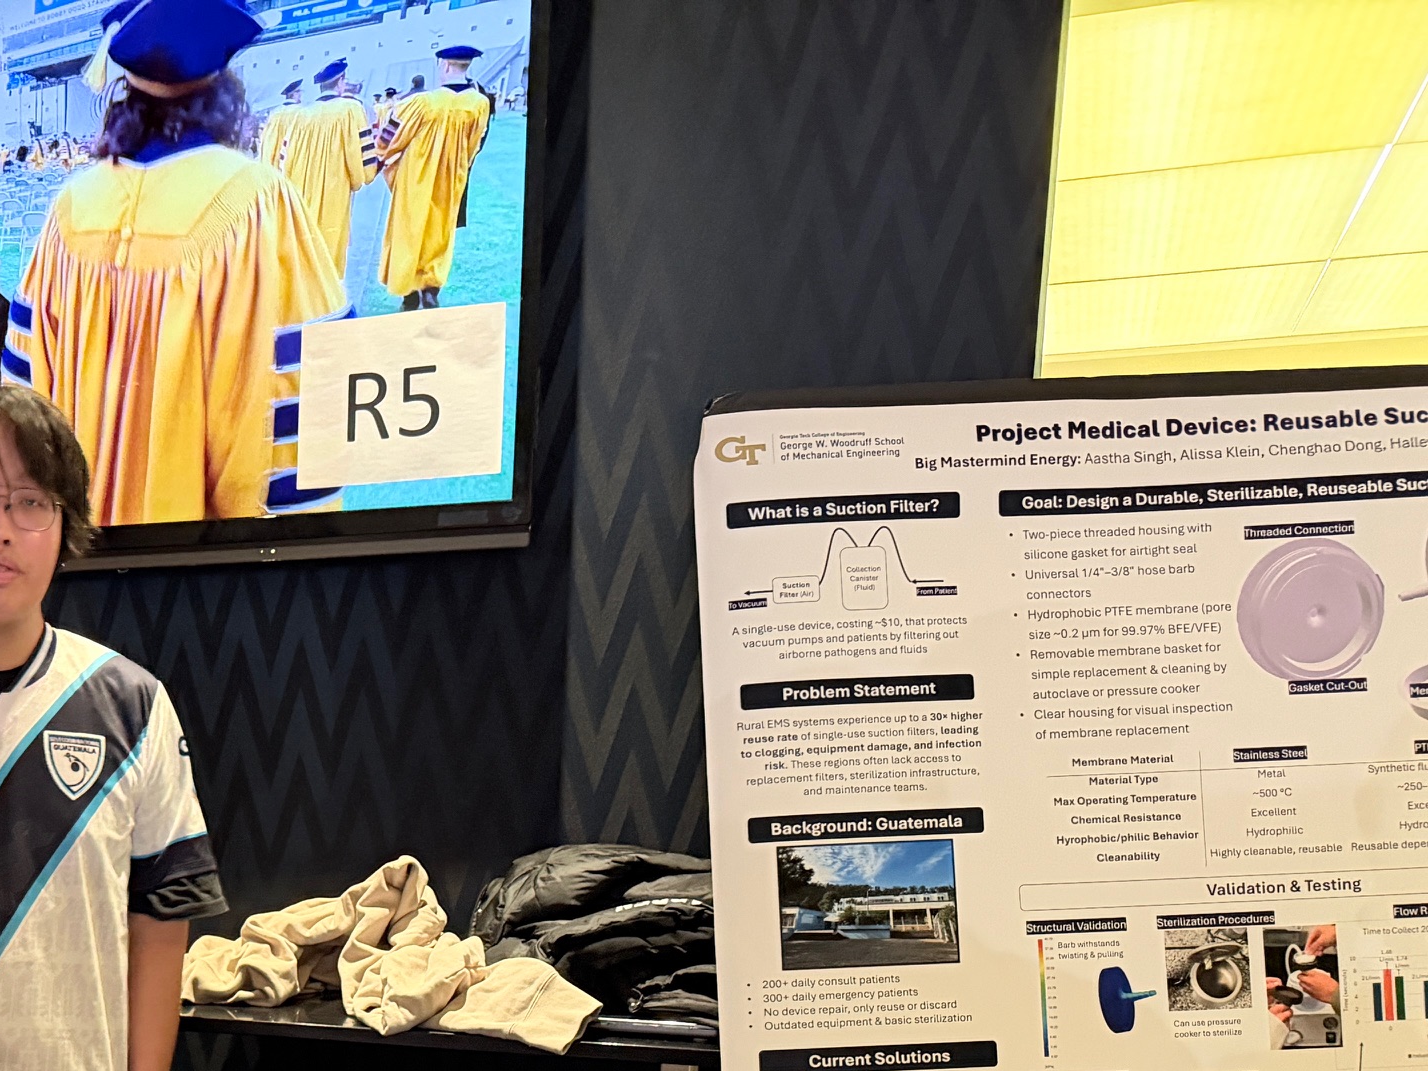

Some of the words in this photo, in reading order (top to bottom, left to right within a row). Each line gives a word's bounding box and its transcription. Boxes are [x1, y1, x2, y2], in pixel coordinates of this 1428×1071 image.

[347, 365, 440, 442] R5
[975, 422, 1062, 446] Project
[1067, 419, 1161, 440] Medical
[1165, 416, 1257, 437] Device:
[1263, 409, 1378, 432] Reusable
[780, 441, 813, 451] George
[815, 439, 828, 448] W.
[829, 437, 872, 448] Woodruff
[874, 436, 905, 446] School
[780, 452, 790, 462] of
[792, 449, 844, 461] Mechanical
[845, 447, 901, 460] Engineering
[914, 456, 938, 472] Big
[940, 453, 1027, 468] Mastermind
[1029, 453, 1081, 468] Energy:
[1084, 452, 1131, 465] Aastha
[1133, 450, 1176, 465] Singh,
[1179, 448, 1223, 461] Alissa
[1226, 445, 1265, 459] Klein,
[1268, 442, 1342, 457] Chenghao
[1344, 440, 1387, 453] Dong,
[1021, 495, 1063, 510] Goal:
[1066, 494, 1119, 510] Design
[1122, 496, 1133, 507] a
[1135, 490, 1204, 506] Durable,
[1206, 484, 1304, 502] Sterilizable,
[1306, 479, 1394, 497] Reuseable
[747, 505, 793, 521] What
[795, 503, 810, 518] is
[812, 506, 823, 517] a
[825, 501, 887, 516] Suction
[889, 498, 940, 514] Filter?
[1022, 528, 1082, 542] Two-piece
[1083, 526, 1136, 538] threaded
[1138, 524, 1186, 537] housing
[1186, 522, 1212, 534] with
[1244, 526, 1292, 538] Threaded
[1294, 523, 1354, 535] Connection
[845, 566, 882, 574] Collection
[849, 575, 879, 583] Canister
[1027, 607, 1102, 623] Hydrophobic
[1104, 605, 1133, 617] PTFE
[1135, 604, 1199, 616] membrane
[1201, 602, 1232, 615] (pore
[731, 626, 740, 636] A
[741, 623, 796, 636] single-use
[797, 620, 835, 631] device,
[836, 618, 874, 630] costing
[874, 617, 903, 628] ~$10,
[904, 617, 926, 627] that
[926, 616, 968, 628] protects
[1028, 629, 1051, 640] size
[1053, 628, 1079, 639] ~0.2
[1102, 626, 1120, 637] for
[1121, 624, 1166, 637] 99.97%
[1167, 621, 1222, 635] BFE/VFE)
[782, 685, 851, 701] Problem
[853, 682, 937, 698] Statement
[1289, 682, 1324, 693] Gasket
[1328, 680, 1368, 691] Cut-Out
[54, 744, 96, 754] GUATEMALA
[1233, 750, 1280, 761] Stainless
[1282, 748, 1308, 759] Steel
[746, 773, 814, 787] replacement
[814, 772, 848, 782] filters,
[849, 769, 908, 781] sterilization
[909, 767, 980, 778] infrastructure,
[1053, 797, 1075, 807] Max
[1076, 794, 1129, 807] Operating
[1129, 793, 1197, 805] Temperature
[1250, 807, 1297, 818] Excellent
[770, 818, 873, 837] Background:
[875, 814, 963, 831] Guatemala
[1246, 825, 1304, 839] Hydrophilic
[1206, 881, 1286, 896] Validation
[1289, 879, 1301, 893] &
[1303, 877, 1362, 893] Testing
[1026, 922, 1075, 934] Structural
[1076, 919, 1127, 931] Validation
[1157, 916, 1216, 928] Sterilization
[1218, 914, 1275, 926] Procedures
[1057, 941, 1076, 949] Barb
[1076, 939, 1121, 948] withstands
[763, 1007, 780, 1017] No
[781, 1006, 816, 1017] device
[818, 1004, 851, 1016] repair,
[852, 1003, 875, 1015] only
[876, 1003, 905, 1012] reuse
[906, 1003, 918, 1011] or
[919, 999, 958, 1011] discard
[808, 1053, 872, 1068] Current
[874, 1050, 951, 1066] Solutions
